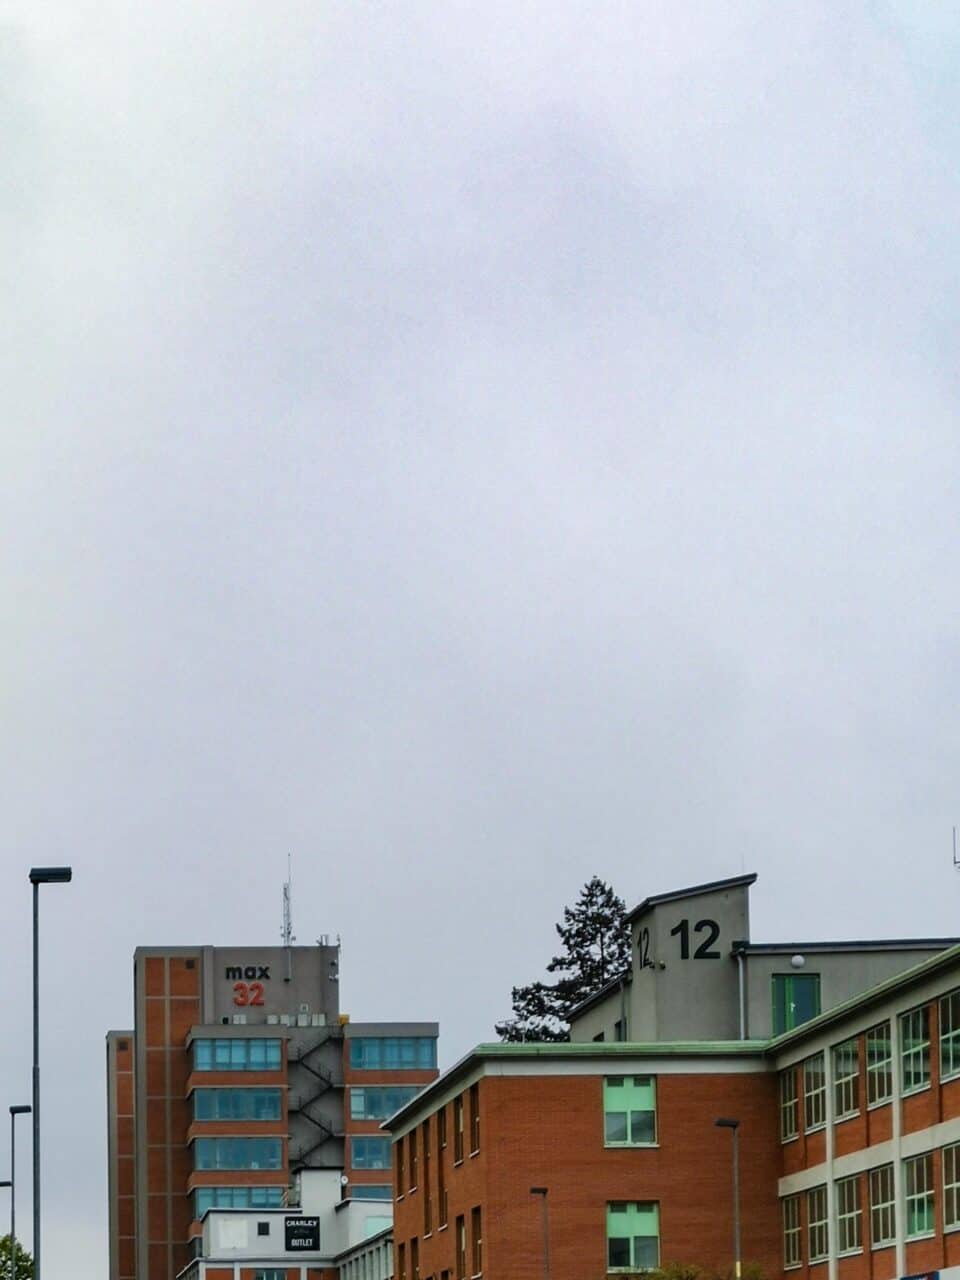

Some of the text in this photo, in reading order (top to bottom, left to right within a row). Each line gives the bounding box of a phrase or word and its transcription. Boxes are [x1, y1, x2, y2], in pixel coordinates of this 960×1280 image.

[637, 927, 652, 970] 12
[669, 919, 721, 960] 12
[225, 966, 270, 980] max
[233, 982, 265, 1007] 32
